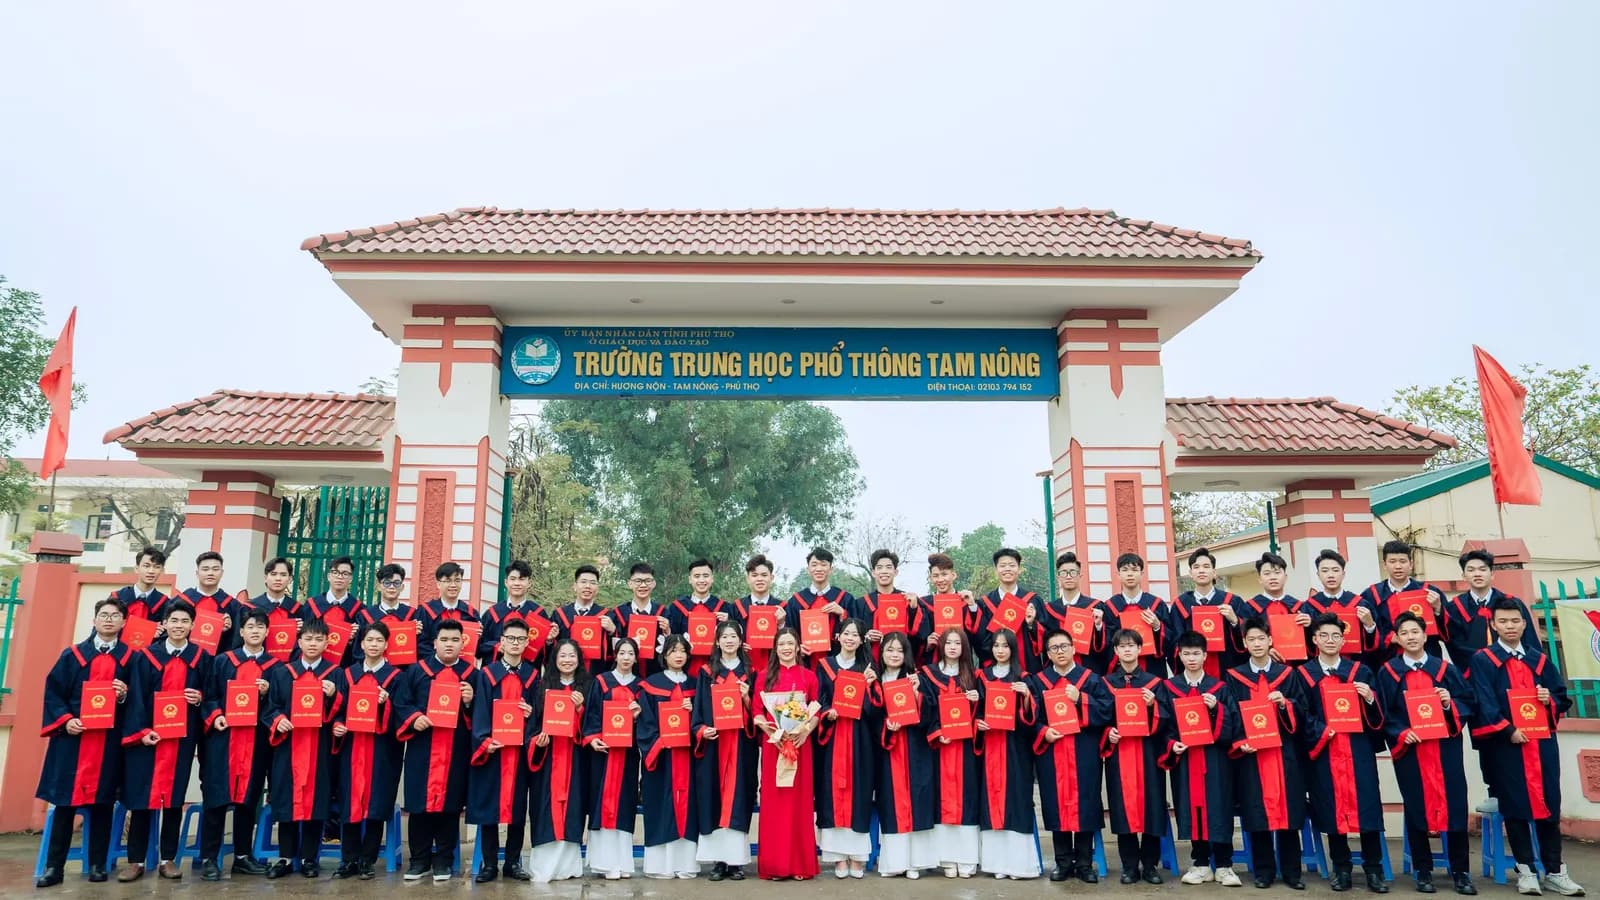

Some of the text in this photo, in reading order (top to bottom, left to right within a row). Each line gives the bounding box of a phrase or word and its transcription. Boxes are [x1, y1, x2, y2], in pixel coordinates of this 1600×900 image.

[573, 340, 1040, 382] TRƯỜNG TRUNG HỌC PHỔ THÔNG TAM NÔNG
[673, 382, 691, 390] TAM
[692, 381, 719, 390] NÔNG
[743, 382, 760, 392] THỌ
[977, 383, 1000, 391] 02103
[1003, 383, 1017, 391] 794
[1019, 383, 1032, 391] 152
